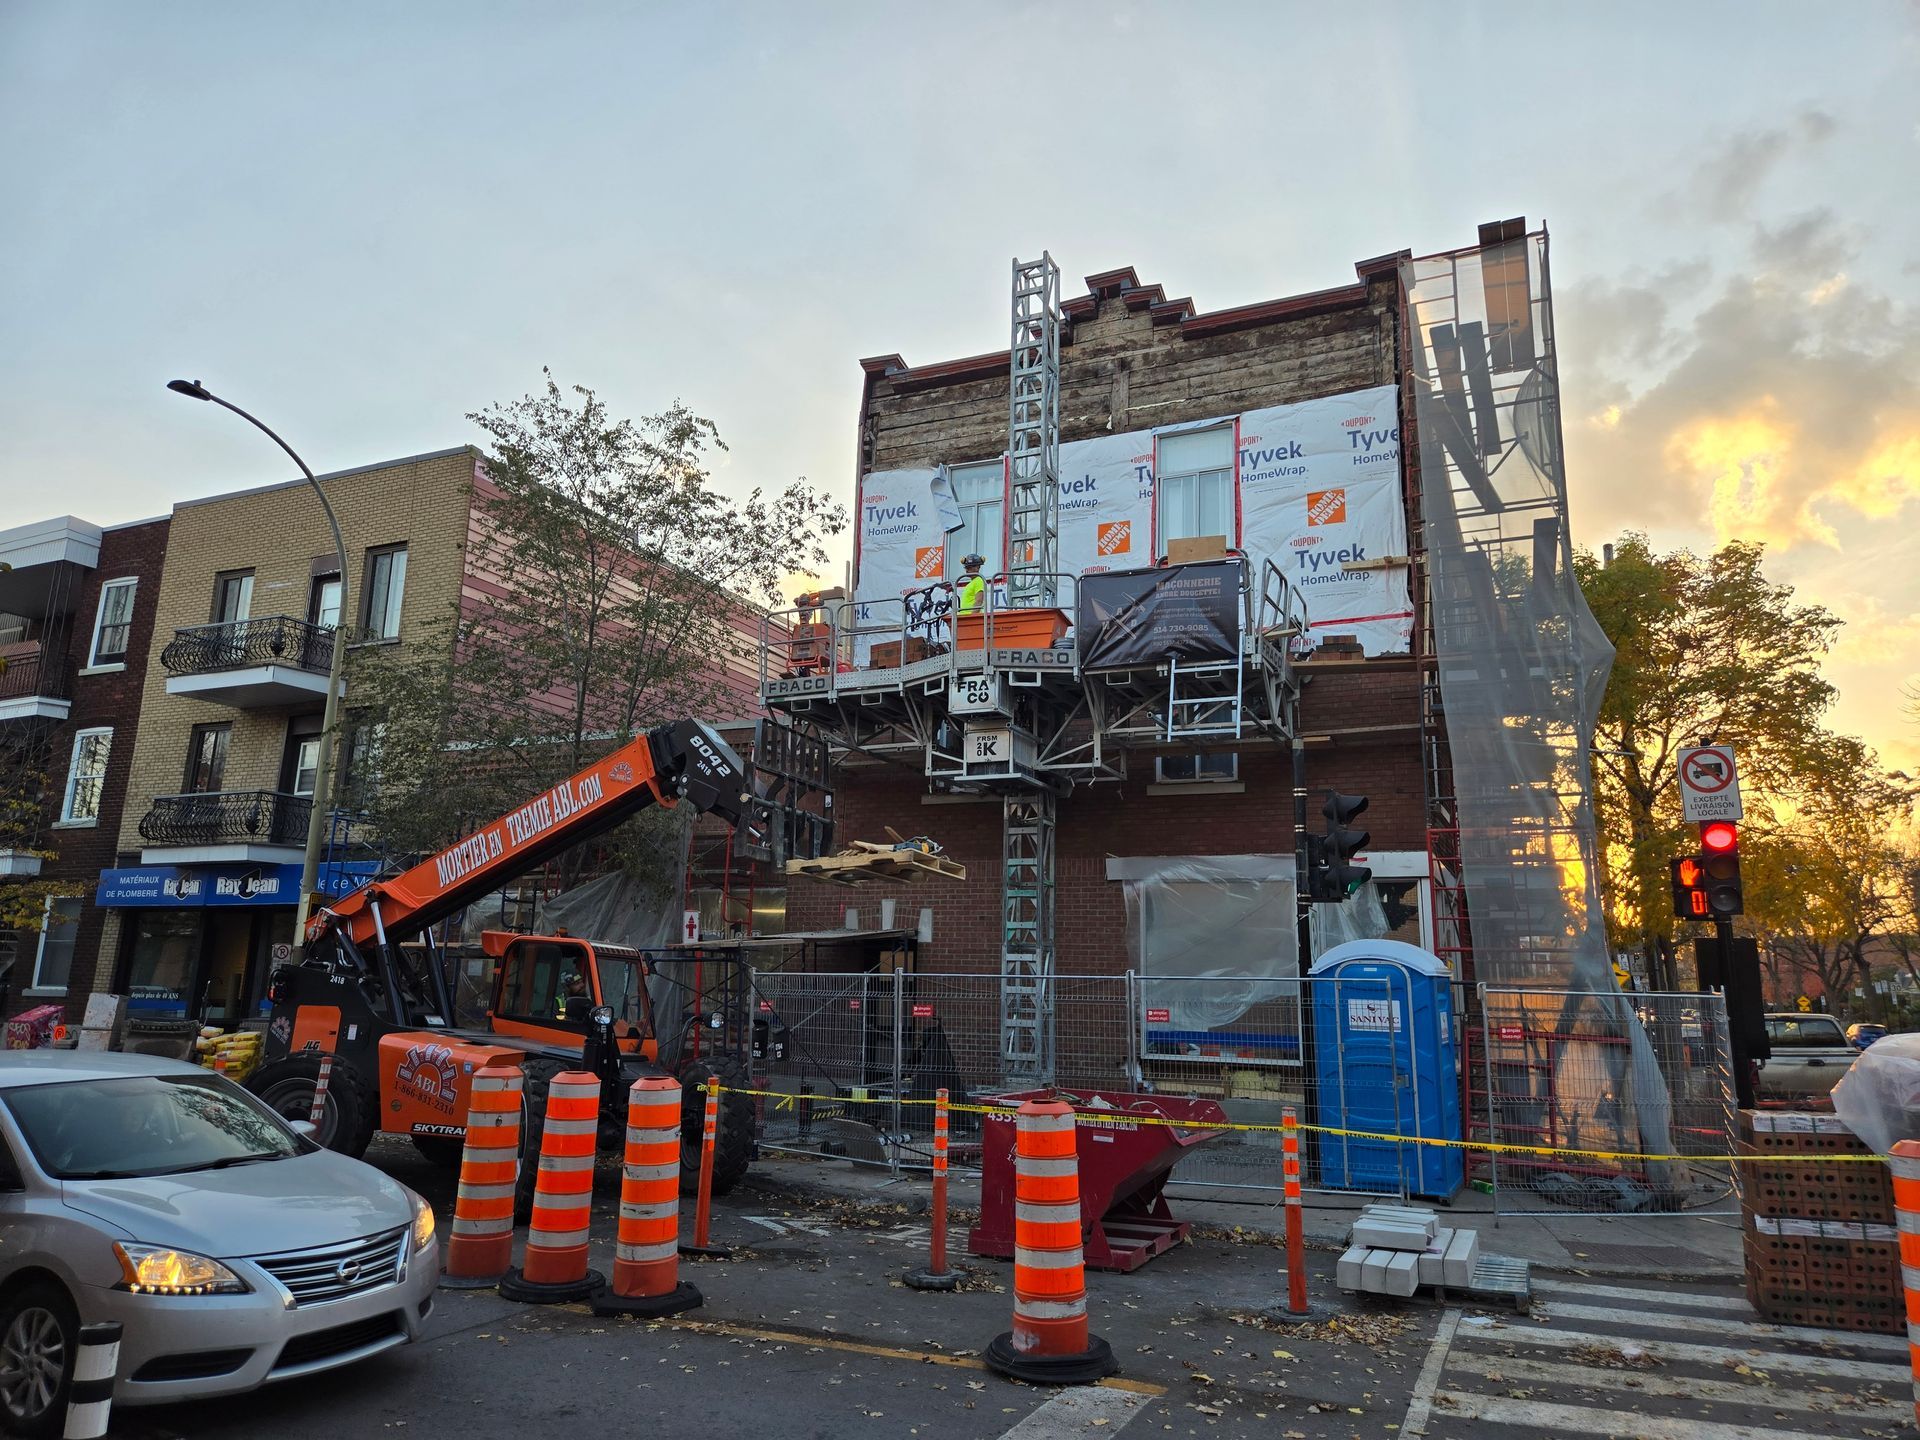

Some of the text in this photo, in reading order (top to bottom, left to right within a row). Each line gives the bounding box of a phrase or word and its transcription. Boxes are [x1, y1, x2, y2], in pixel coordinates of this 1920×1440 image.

[1344, 417, 1373, 428] DUPONT
[1239, 440, 1303, 470] Tyvek
[1240, 465, 1306, 484] HomeWrap
[865, 495, 886, 504] DUPONT
[1307, 489, 1337, 520] HOME
[865, 500, 917, 526] Tyvek
[1313, 493, 1346, 526] DEPOT
[867, 524, 919, 536] HomeWrap
[1098, 521, 1124, 549] HOME
[1103, 524, 1131, 555] DEPOT
[1292, 537, 1320, 547] DUPONT
[916, 545, 939, 572] HOME
[1295, 543, 1365, 572] Tyvek
[1084, 565, 1108, 575] DUPONT
[1301, 571, 1370, 587] HomeWrap
[1169, 624, 1209, 632] 730-9085
[998, 650, 1070, 664] FRACO
[768, 677, 825, 694] FRACO
[957, 680, 989, 693] FRA
[967, 692, 989, 704] CO
[976, 735, 998, 743] FRSM
[689, 735, 731, 777] 8042
[696, 759, 712, 776] 2418
[1690, 801, 1734, 811] LIVRAISON
[435, 773, 604, 888] MORTIER EN TREMIE ABL.COM
[119, 875, 160, 885] MATÉRIAUX
[163, 878, 202, 896] Ray Jean
[216, 877, 279, 895] Ray Jean
[106, 889, 158, 898] DE PLOMBERIE
[330, 975, 345, 985] 2418
[168, 992, 180, 1000] ANS
[304, 1041, 320, 1049] JLG
[413, 1073, 439, 1096] ABL
[393, 1080, 455, 1116] 1-866-831-2310
